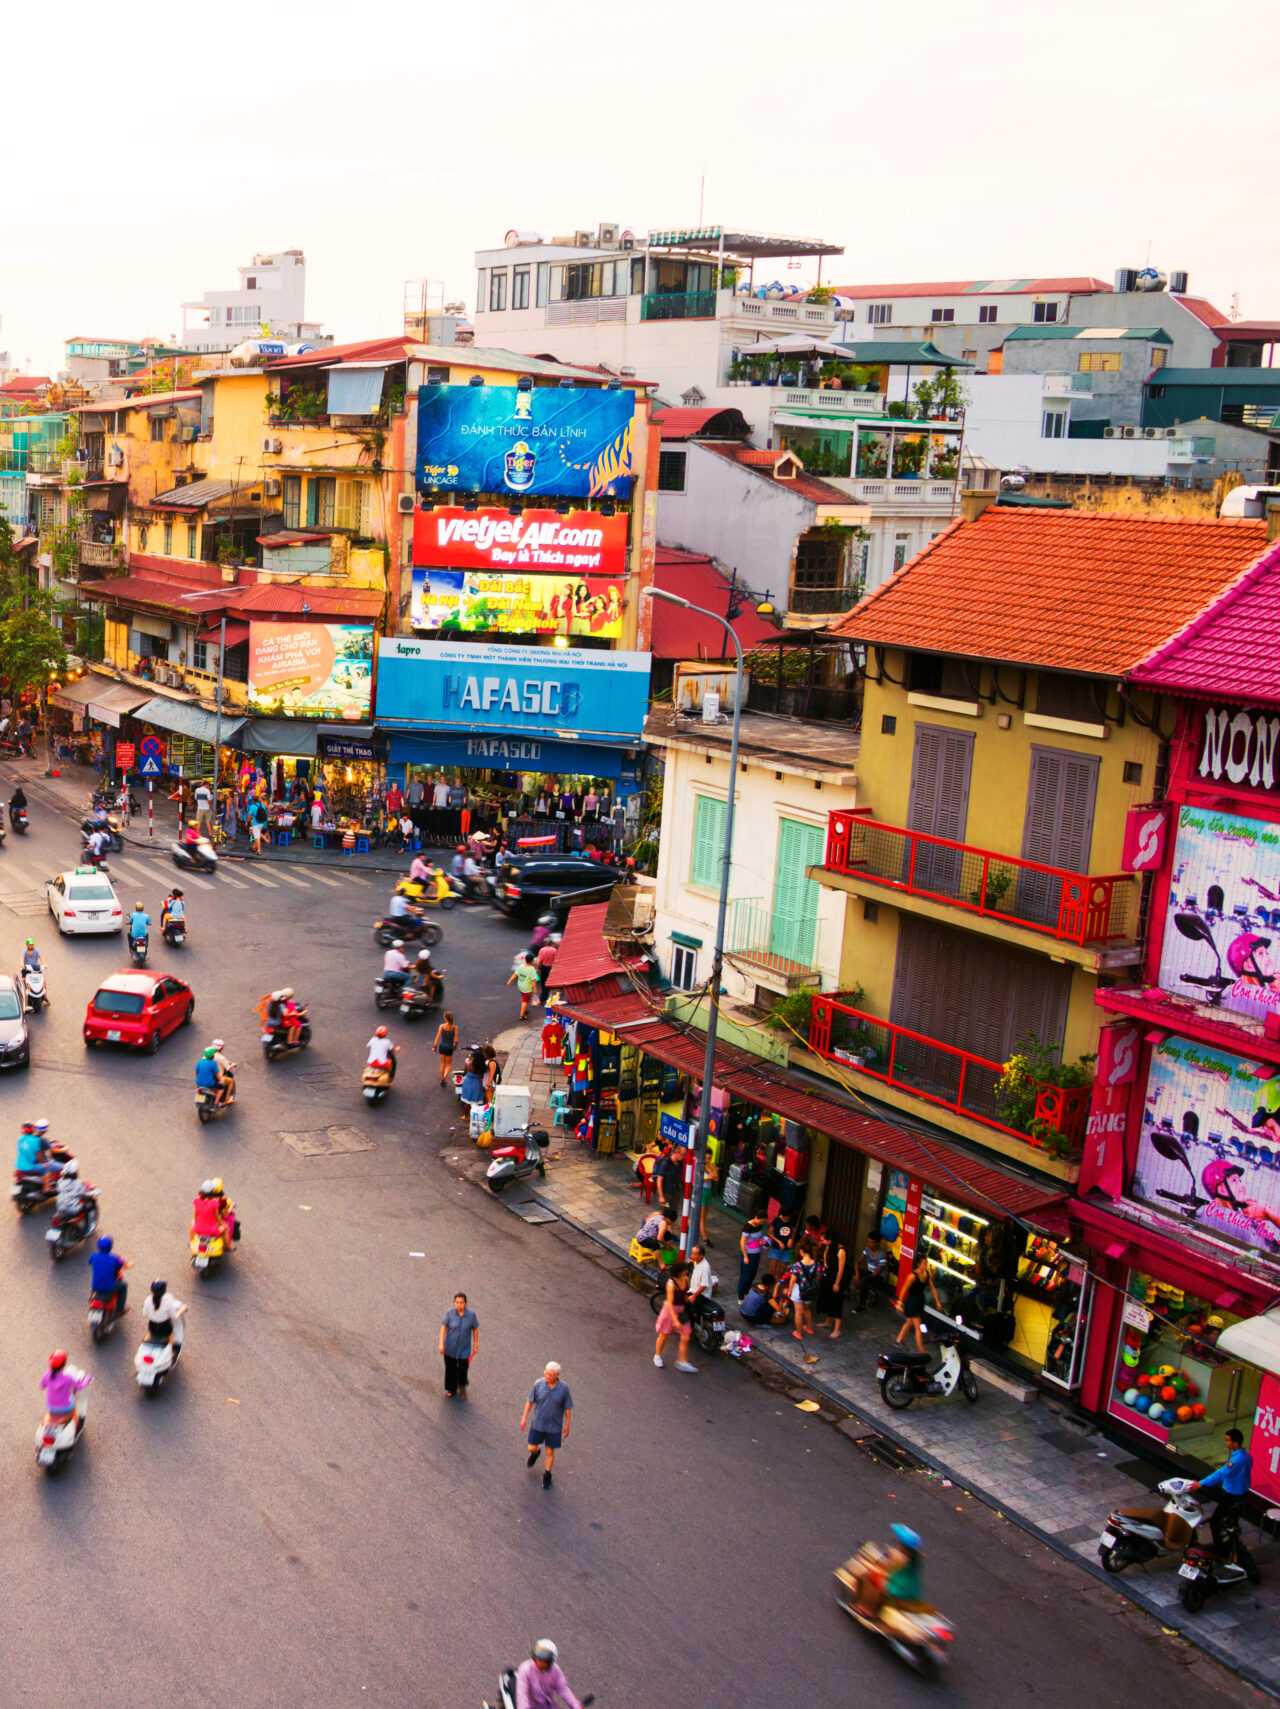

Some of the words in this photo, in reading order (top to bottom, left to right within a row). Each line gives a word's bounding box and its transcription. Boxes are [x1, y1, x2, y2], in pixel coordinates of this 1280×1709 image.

[460, 423, 494, 436] ĐÁNH
[498, 423, 529, 437] THỨC
[424, 465, 446, 476] Tiger
[507, 455, 535, 471] Tiger
[424, 477, 458, 485] UNCAGE
[491, 549, 514, 565] Bay
[532, 549, 564, 563] Thích
[566, 552, 601, 566] ngay!
[512, 598, 544, 611] Nam
[497, 613, 560, 631] Bangkok
[467, 737, 541, 760] HAFASCO
